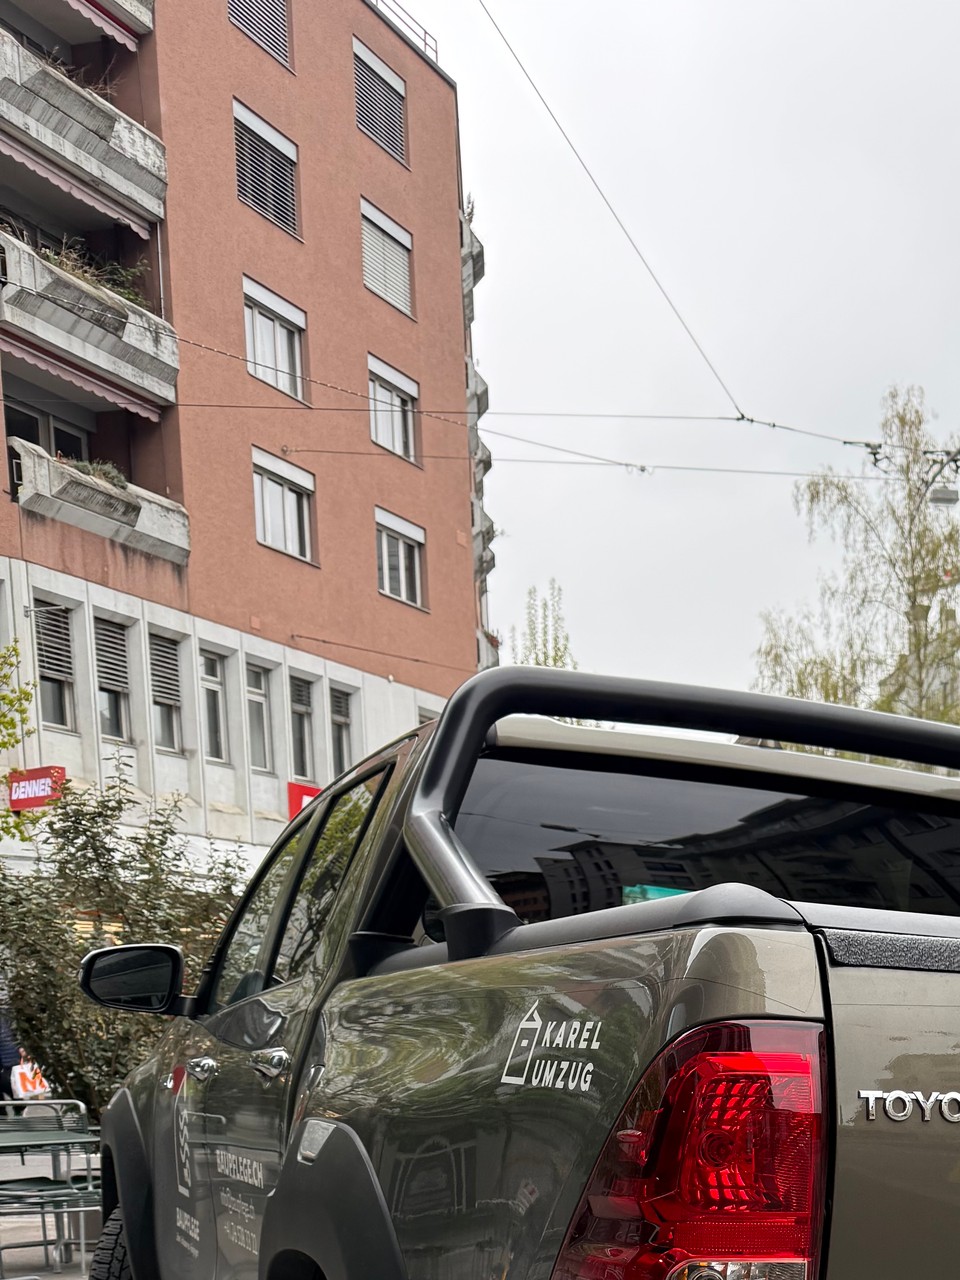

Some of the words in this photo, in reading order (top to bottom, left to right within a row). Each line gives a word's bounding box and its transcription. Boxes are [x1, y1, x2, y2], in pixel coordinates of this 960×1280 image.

[11, 777, 52, 800] DENNER
[541, 1021, 602, 1049] KAREL
[531, 1059, 594, 1091] UMZUG
